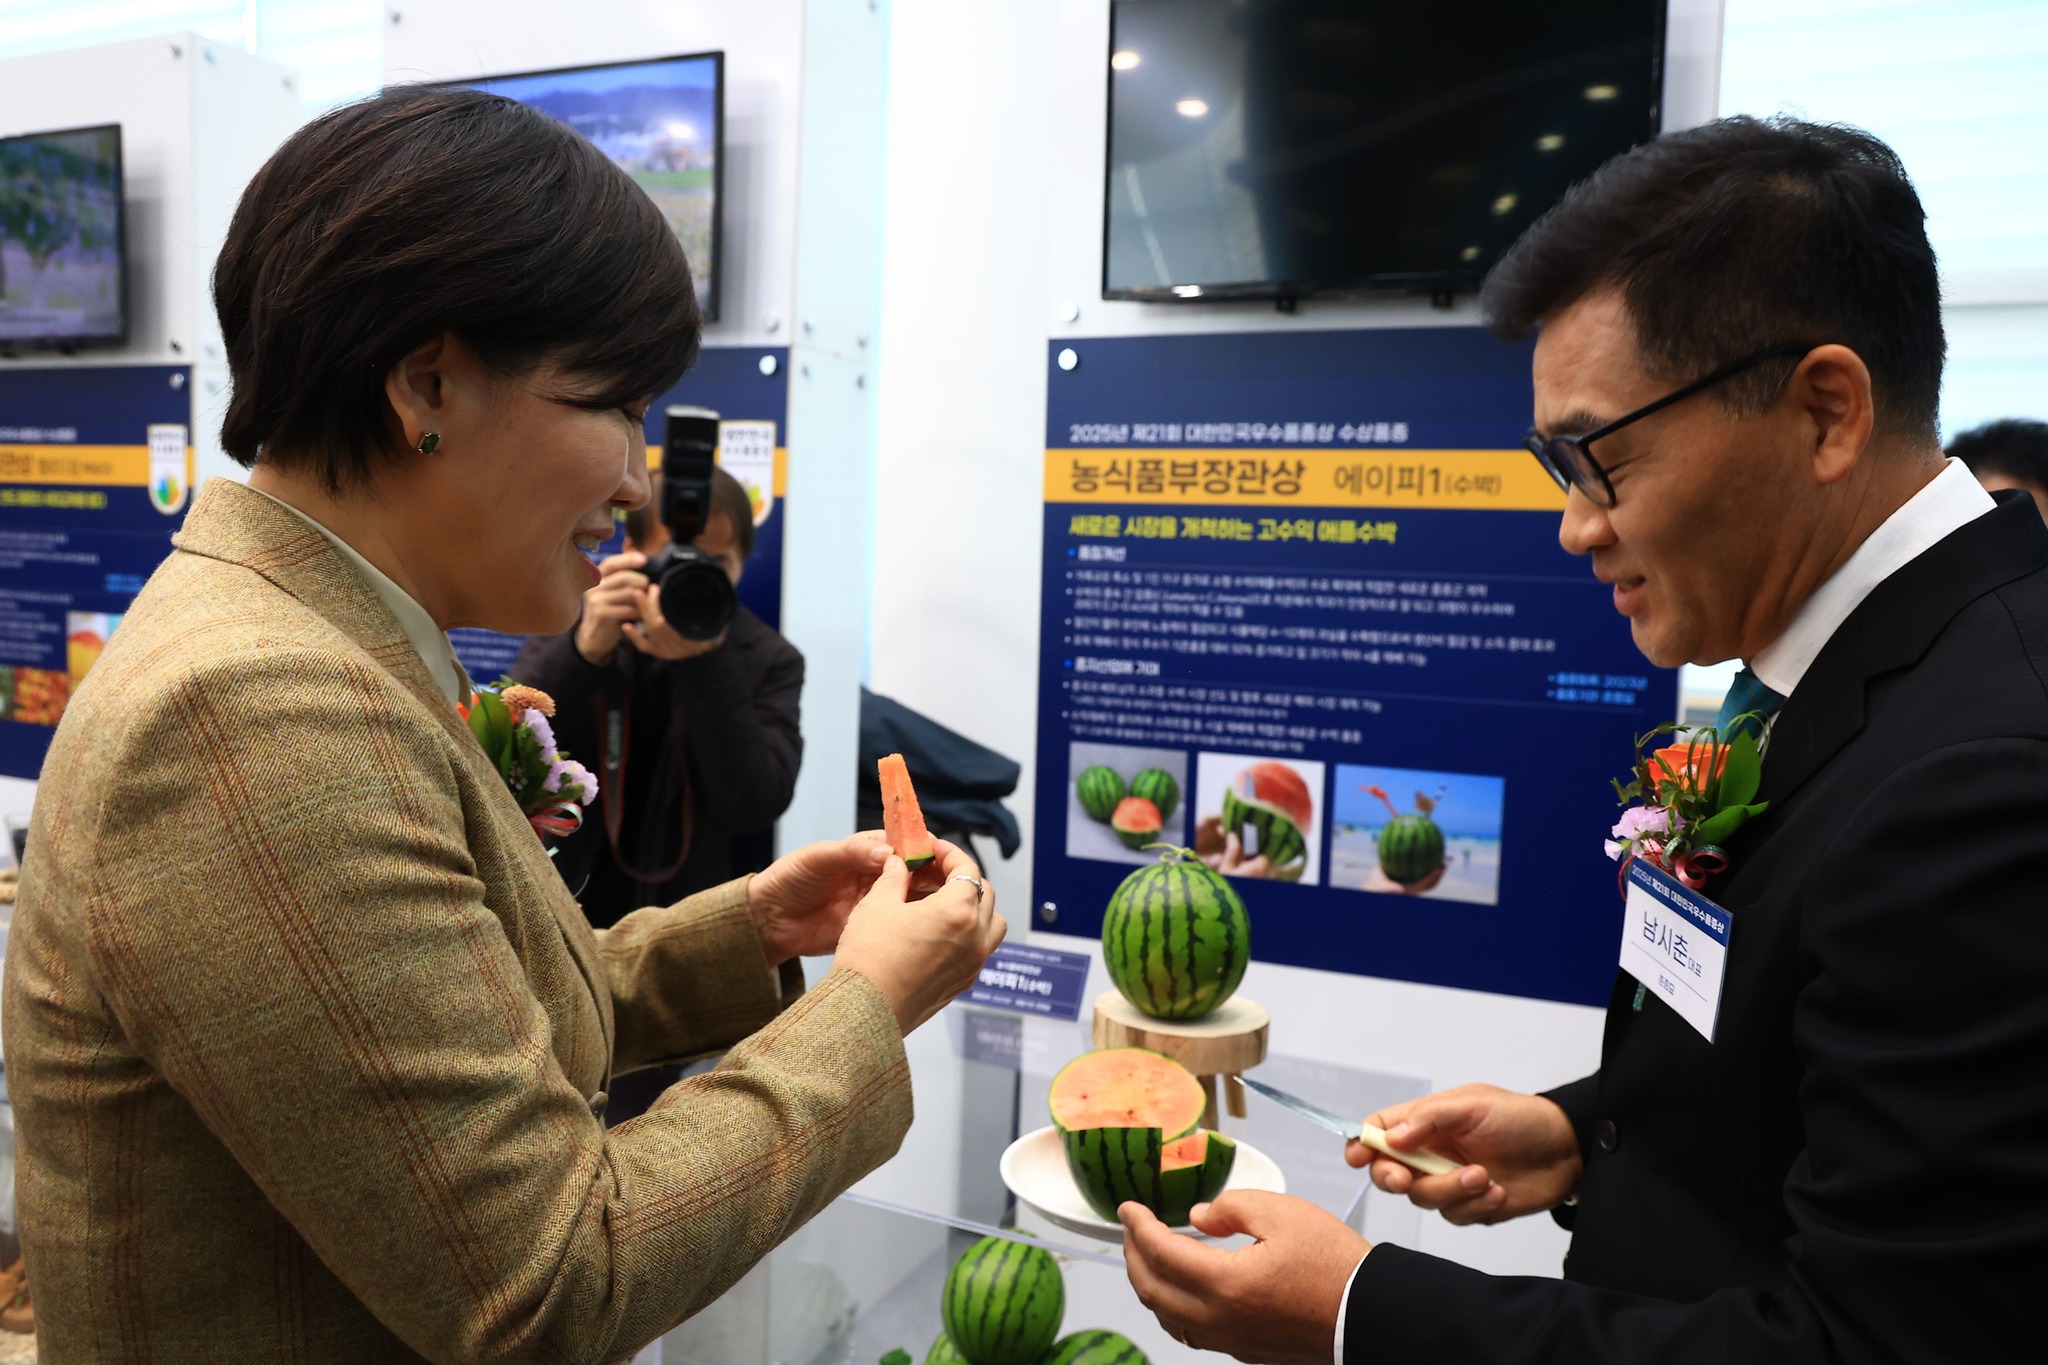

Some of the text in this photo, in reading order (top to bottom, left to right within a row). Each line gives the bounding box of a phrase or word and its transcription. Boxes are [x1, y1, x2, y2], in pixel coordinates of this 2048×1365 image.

[1069, 423, 1129, 443] 2025년
[1132, 423, 1182, 443] 제21회
[1071, 458, 1306, 496] 농식품부장관상
[1256, 518, 1316, 543] 고수익
[1317, 519, 1398, 545] 애플수박
[1652, 877, 1670, 899] 제21회
[1643, 911, 1688, 967] 남시춘
